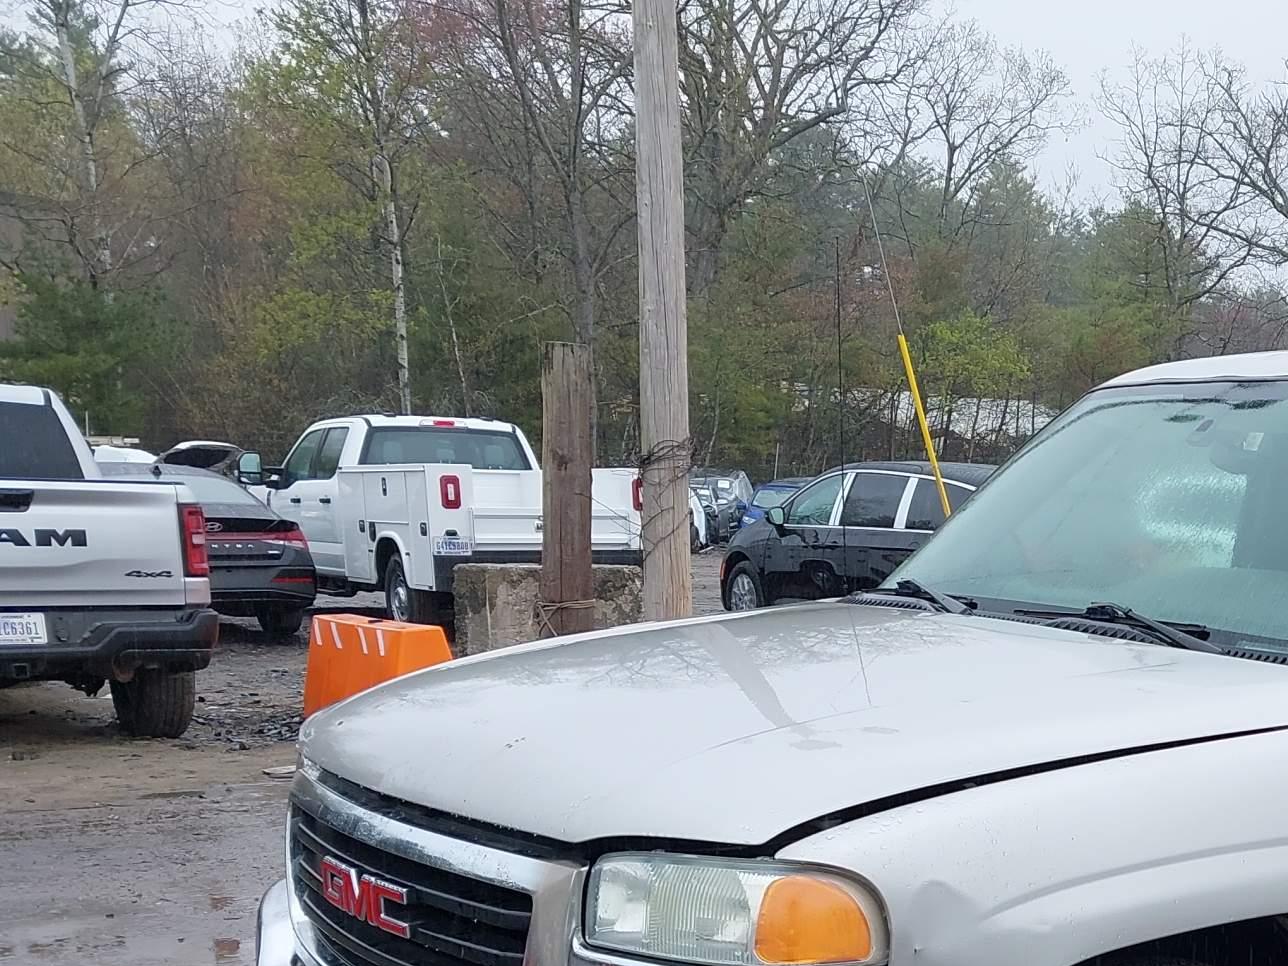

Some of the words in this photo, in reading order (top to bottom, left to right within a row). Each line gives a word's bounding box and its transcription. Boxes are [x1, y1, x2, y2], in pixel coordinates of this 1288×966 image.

[0, 528, 88, 547] AM
[0, 621, 40, 636] C6361
[320, 855, 411, 939] GMC
